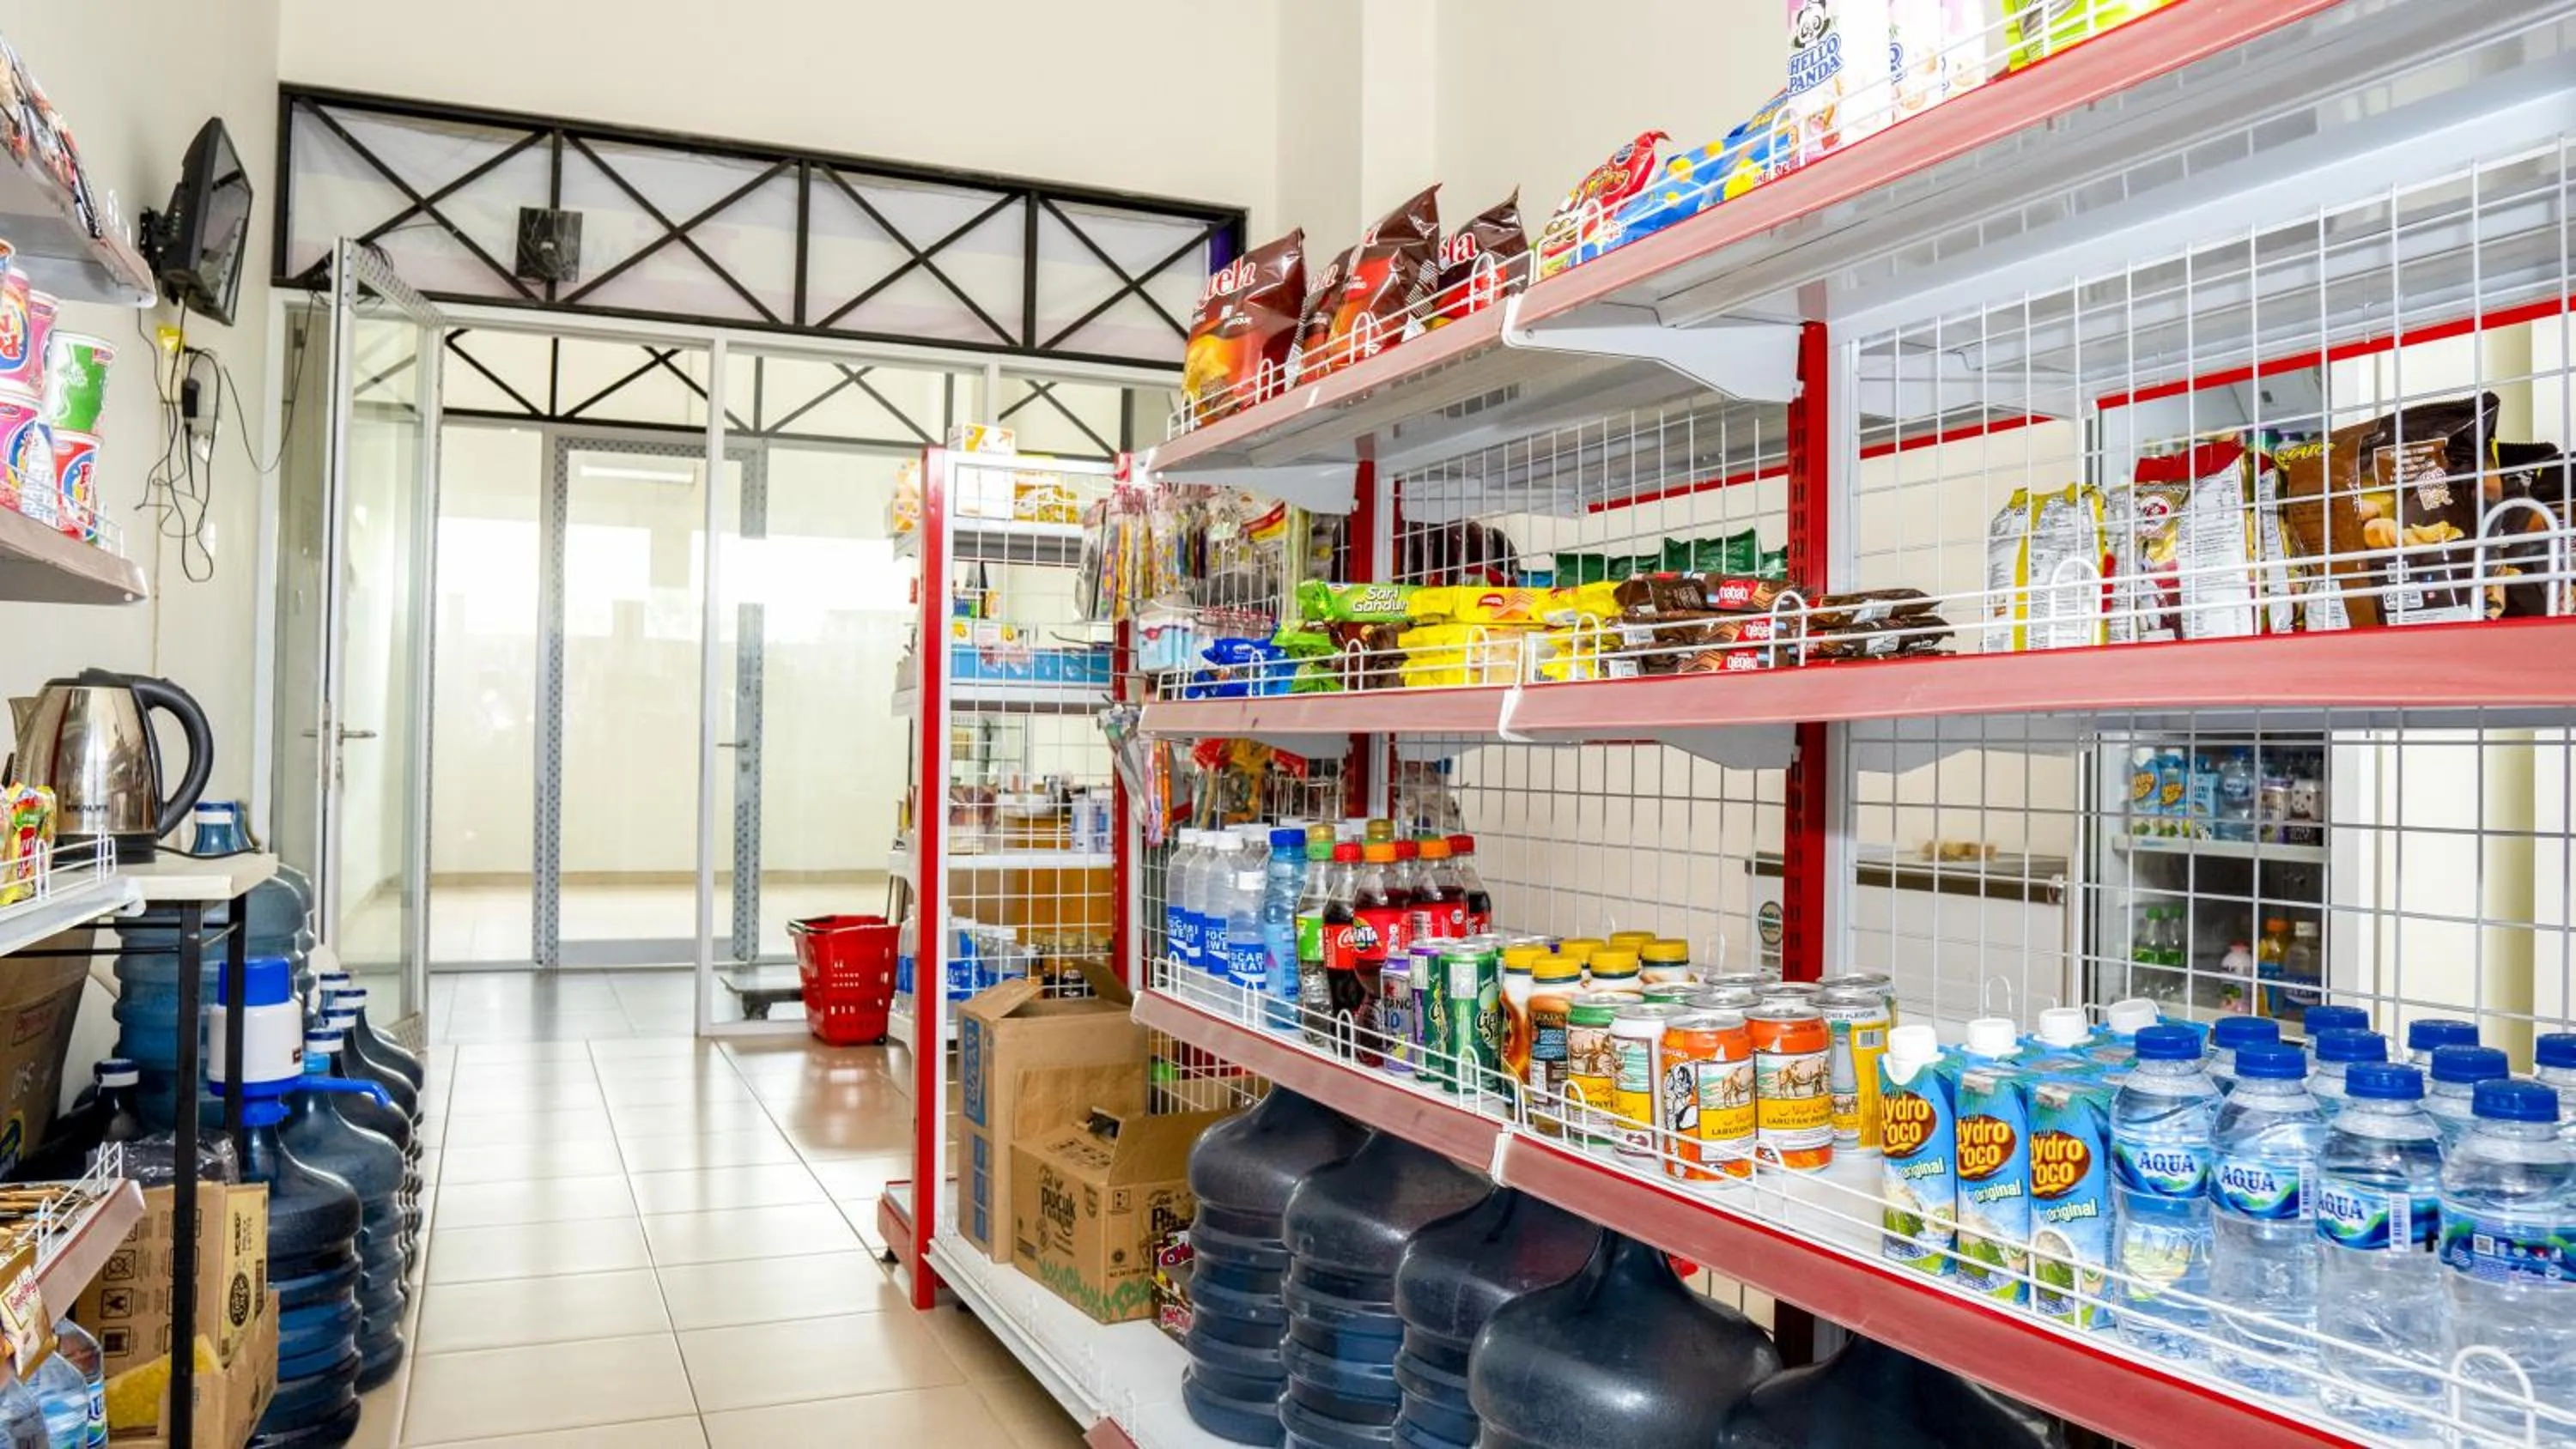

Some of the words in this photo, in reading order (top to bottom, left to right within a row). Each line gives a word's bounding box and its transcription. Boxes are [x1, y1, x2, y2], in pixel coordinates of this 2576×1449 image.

[1789, 35, 1840, 76] HELLO
[1788, 56, 1843, 94] PANDA
[1366, 585, 1400, 600] Sari
[1899, 1157, 1946, 1179] original
[2138, 1151, 2196, 1176] AQUA
[1975, 1179, 2023, 1203] original
[2221, 1165, 2276, 1193] AQUA
[2046, 1197, 2099, 1222] original
[2318, 1190, 2365, 1221] AQUA
